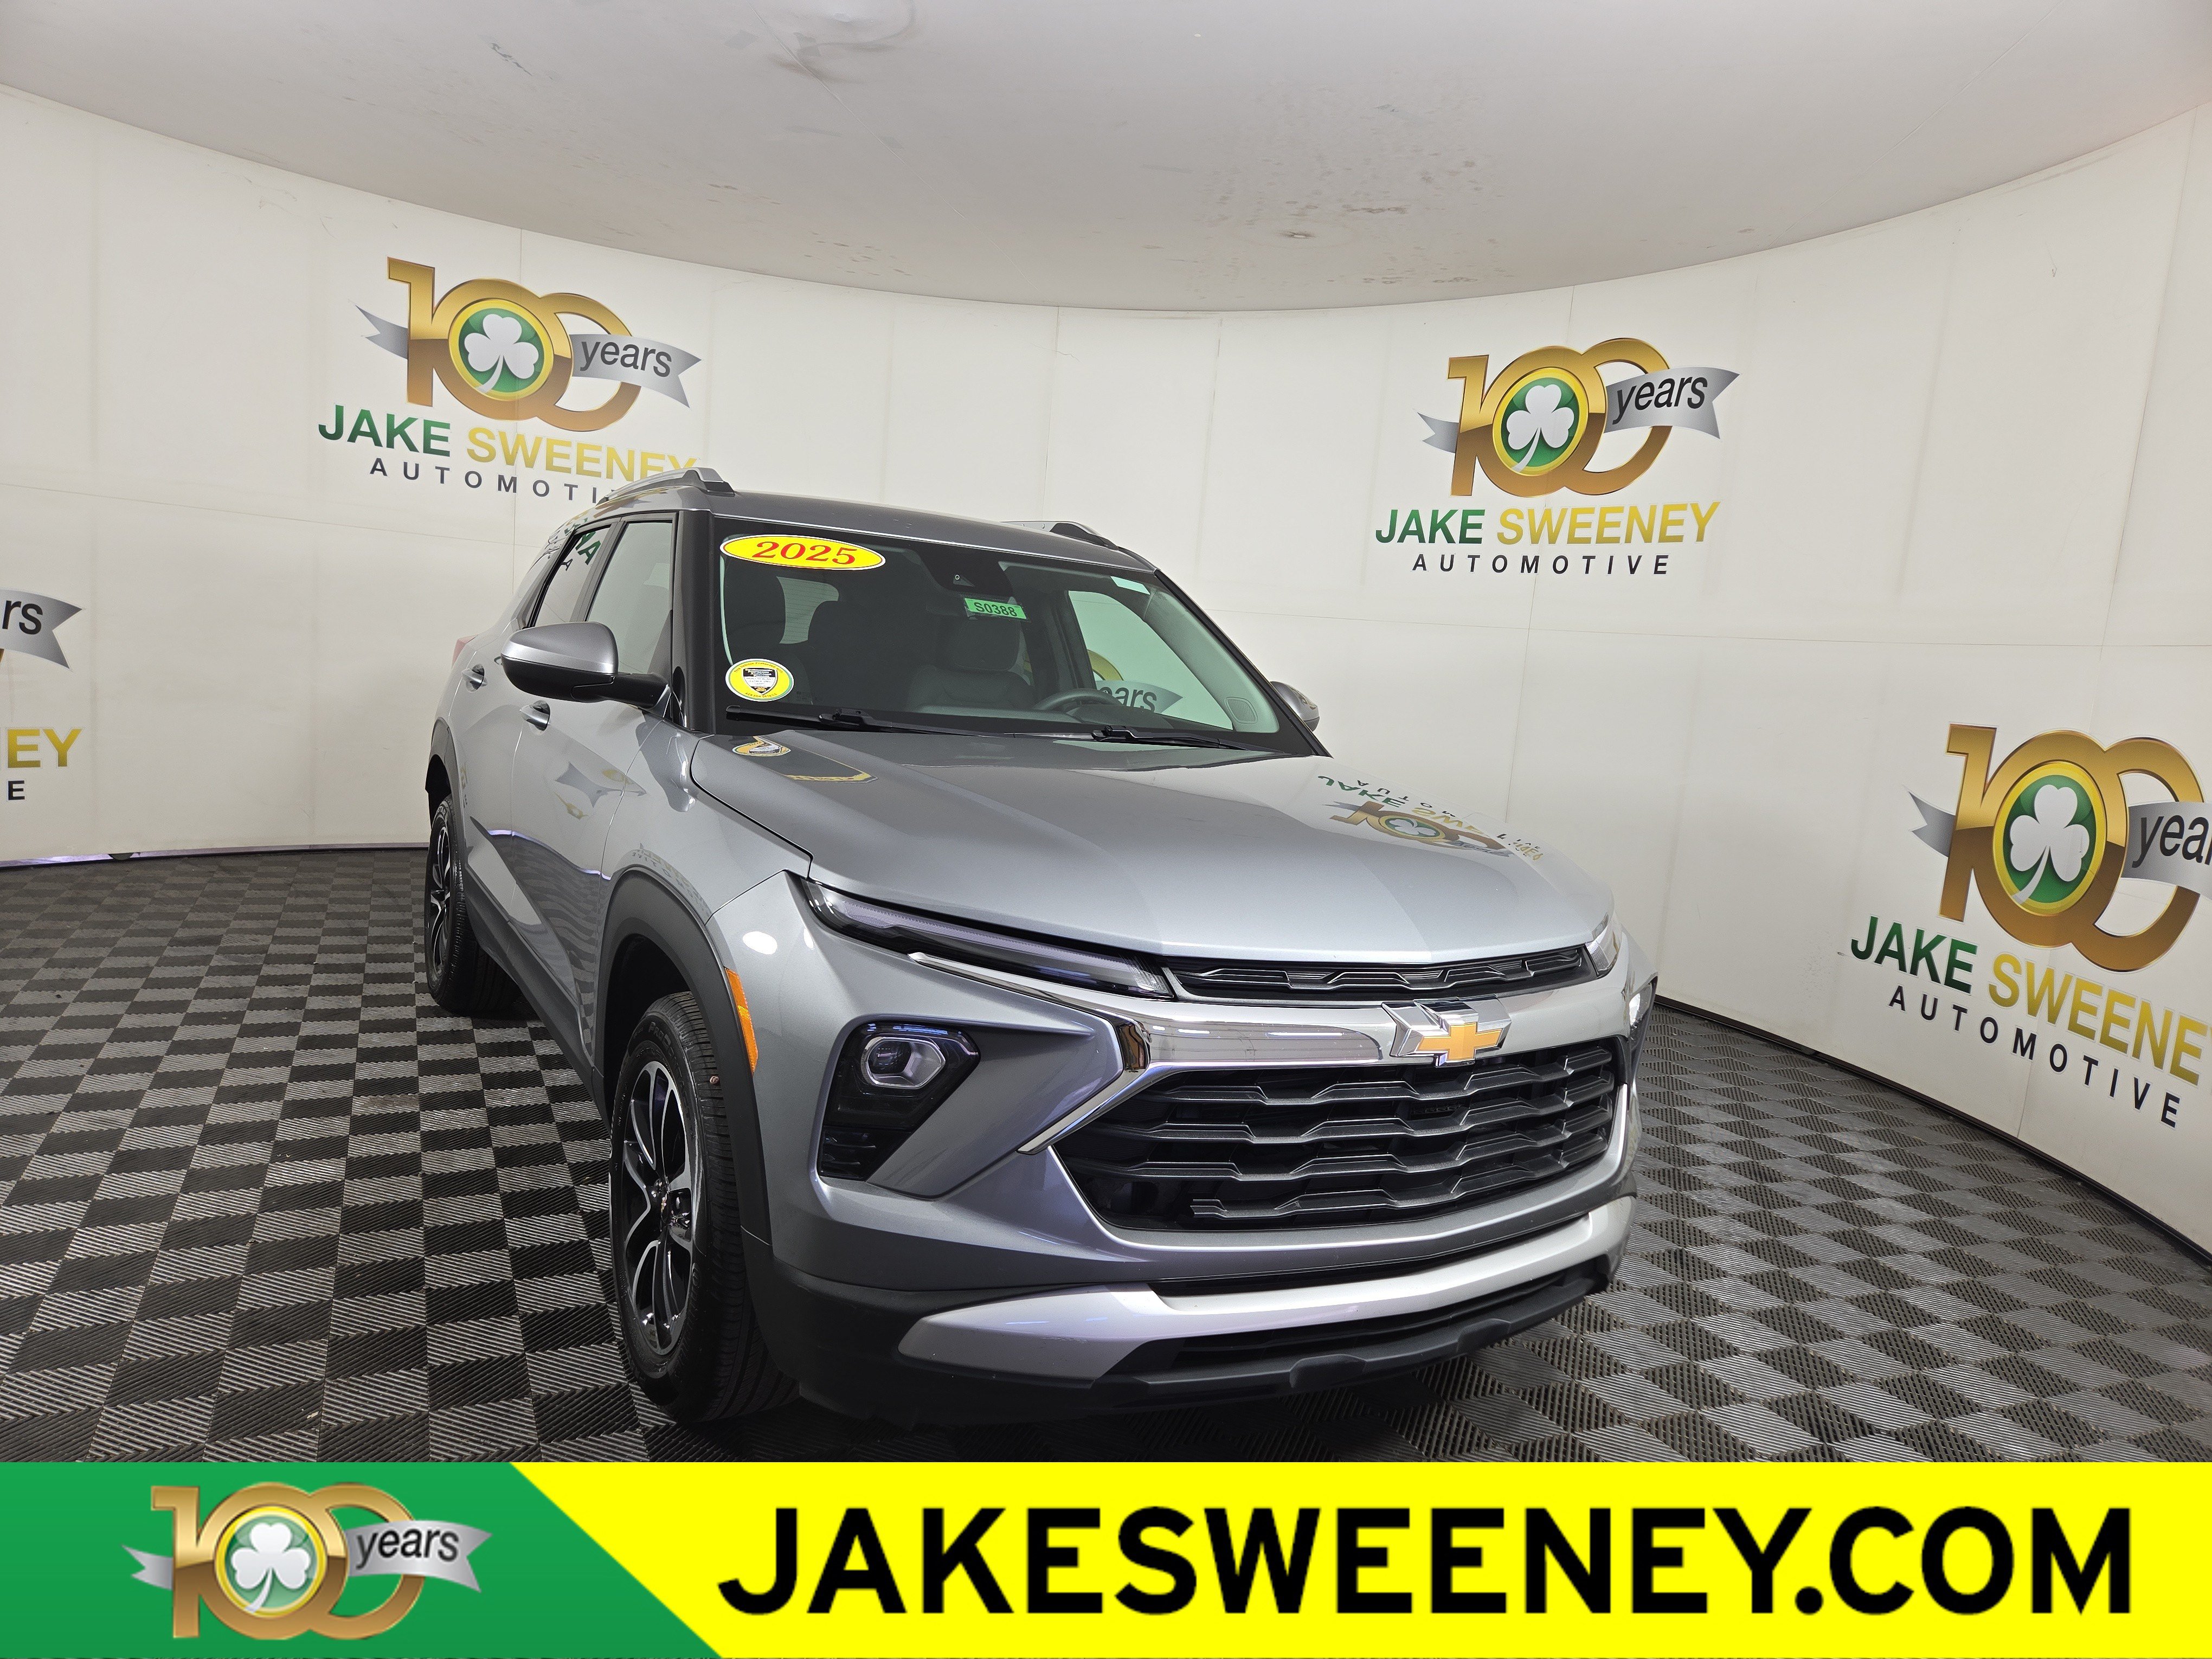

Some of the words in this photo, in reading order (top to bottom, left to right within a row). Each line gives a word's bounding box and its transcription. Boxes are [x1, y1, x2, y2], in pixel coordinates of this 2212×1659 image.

[387, 256, 641, 432] 100
[580, 341, 672, 377] years
[1448, 337, 1671, 498] 100
[1612, 375, 1709, 426] years
[318, 404, 451, 457] JAKE
[369, 458, 615, 504] AUTOMOTI
[1375, 509, 1486, 544] JAKE
[1497, 501, 1721, 545] SWEENEY
[752, 541, 857, 564] 2025
[1412, 554, 1669, 575] AUTOMOTIVE
[974, 602, 1017, 617] S0388
[1099, 686, 1157, 713] ars
[1939, 723, 2205, 973] 100
[2132, 815, 2212, 868] yea
[1851, 916, 1978, 993] JAKE
[1988, 954, 2212, 1086] SWEENE
[1889, 985, 2180, 1128] AUTOMOTIVE
